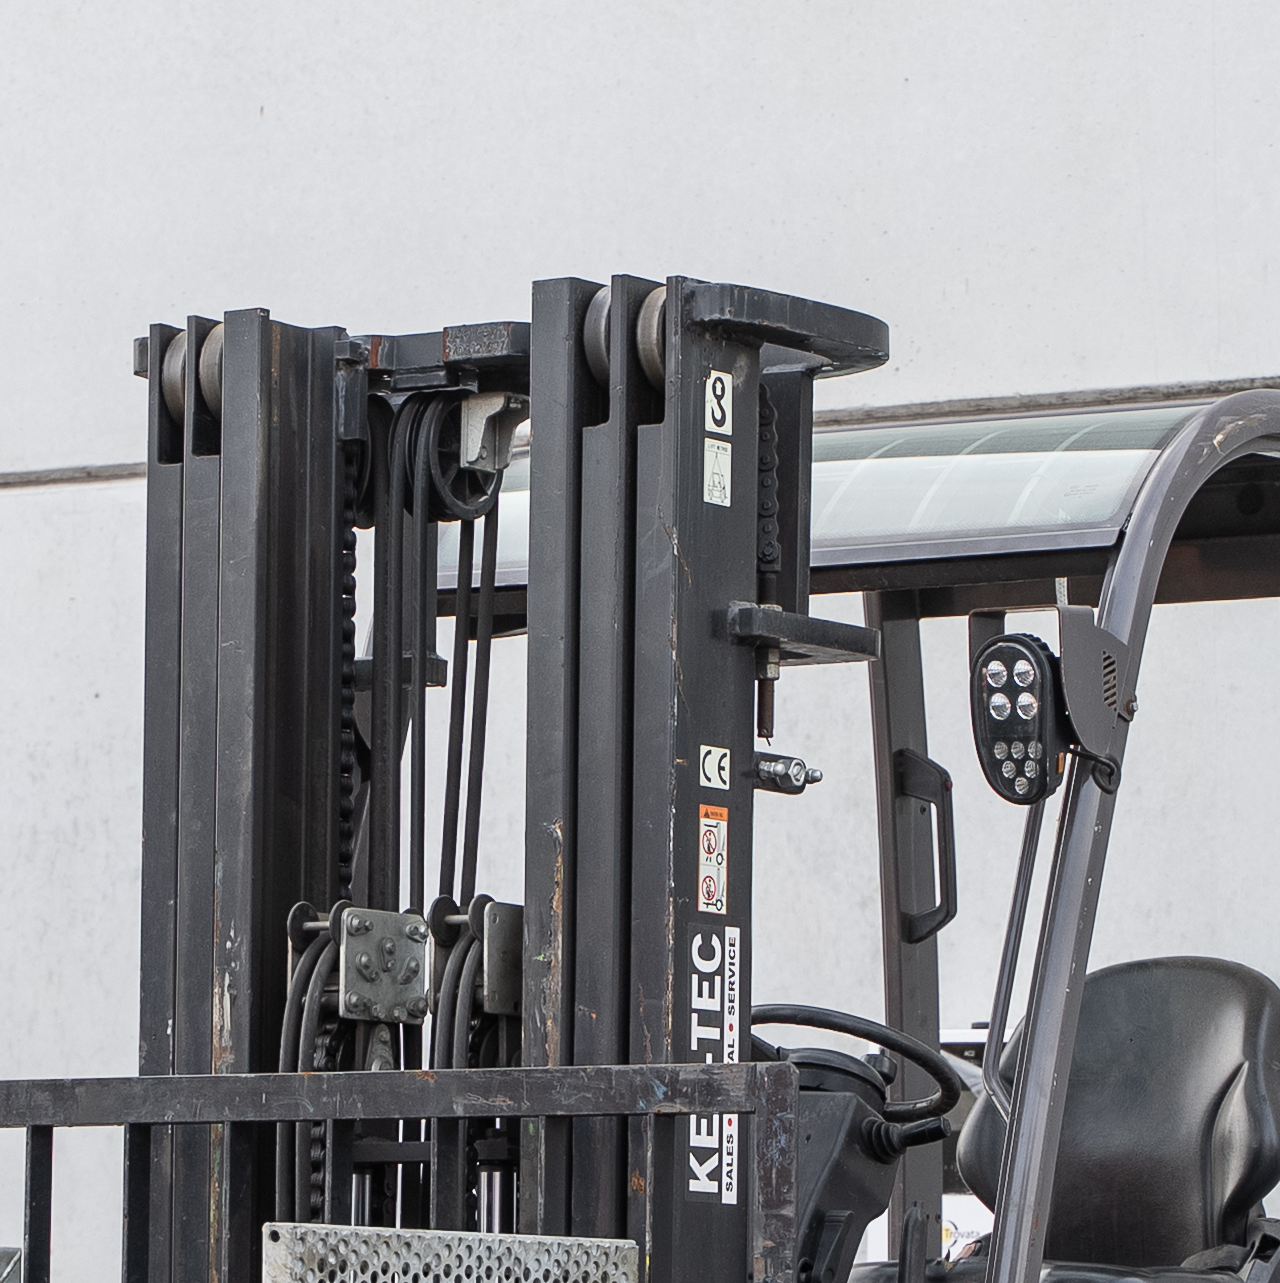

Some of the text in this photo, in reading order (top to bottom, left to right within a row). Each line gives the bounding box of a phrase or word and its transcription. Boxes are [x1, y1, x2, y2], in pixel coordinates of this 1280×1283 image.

[702, 749, 728, 786] CE
[727, 936, 736, 1016] SERVICE
[725, 1132, 734, 1193] SALES
